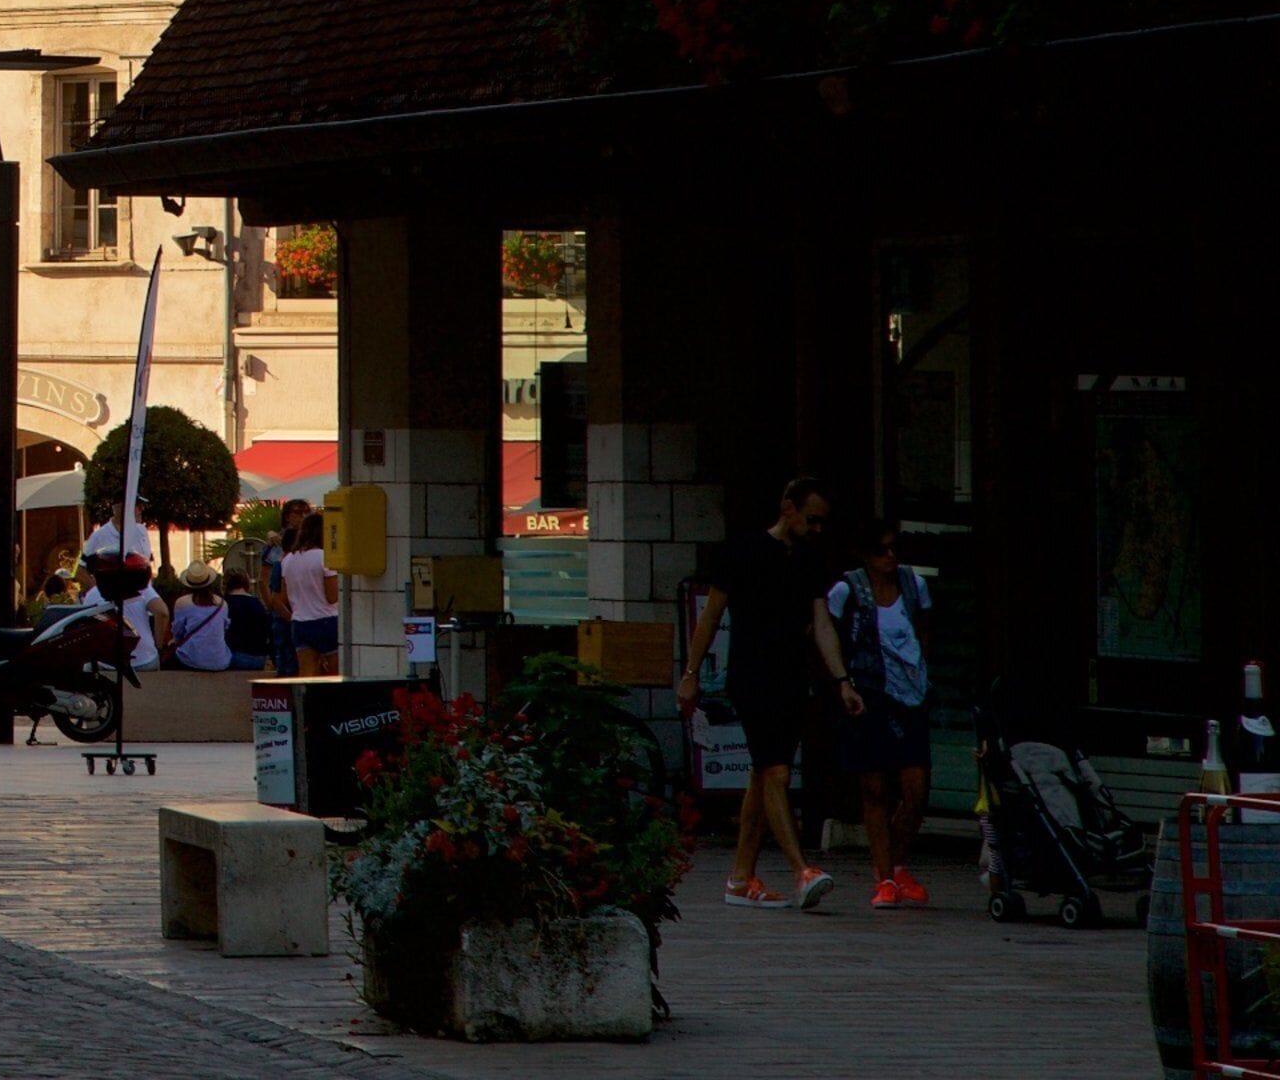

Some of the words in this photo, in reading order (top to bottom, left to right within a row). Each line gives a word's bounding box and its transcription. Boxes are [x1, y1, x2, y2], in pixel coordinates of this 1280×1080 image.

[526, 515, 560, 531] BAR
[329, 709, 401, 735] VISIOTR
[723, 742, 748, 752] minu
[724, 763, 751, 772] ADUL
